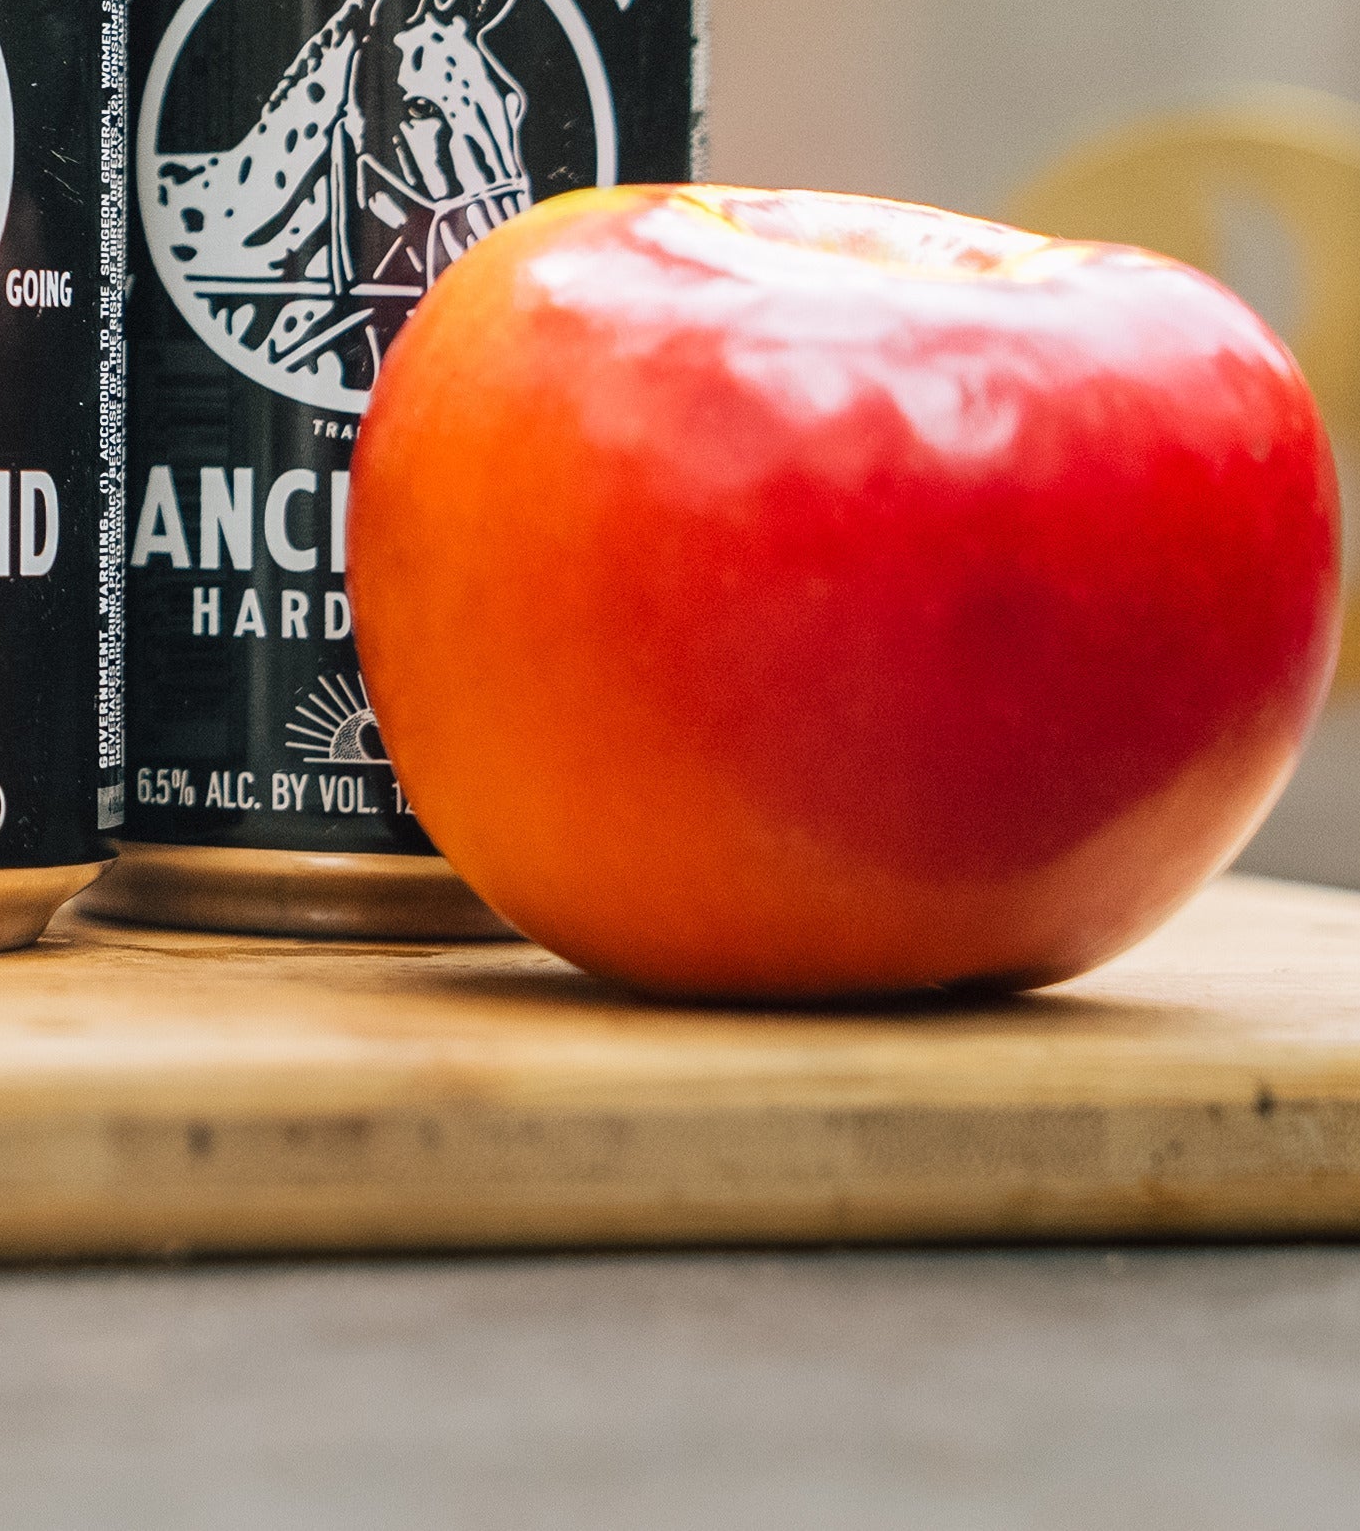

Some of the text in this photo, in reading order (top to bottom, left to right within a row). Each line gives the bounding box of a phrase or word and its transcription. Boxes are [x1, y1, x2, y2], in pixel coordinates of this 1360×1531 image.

[101, 23, 111, 89] WOMEN
[100, 194, 110, 276] SURGEON
[6, 269, 72, 309] GOING
[100, 287, 110, 319] THE
[110, 263, 117, 284] OF
[100, 329, 109, 350] TO
[109, 290, 117, 330] RISK
[109, 336, 117, 361] THE
[100, 361, 109, 461] ACCORDING
[109, 372, 117, 391] OF
[109, 400, 117, 476] BECAUSE
[100, 472, 109, 494] (1)
[108, 484, 117, 588] PREGNANCY
[130, 465, 350, 574] ANC
[99, 511, 108, 615] WARNING:
[108, 594, 116, 660] DURING
[192, 586, 352, 640] HARD
[99, 630, 108, 769] GOVERNMENT
[108, 666, 116, 767] BEVERAGES
[137, 767, 196, 806] 6.5%
[205, 771, 262, 810] ALC.
[272, 772, 308, 811] BY
[318, 774, 378, 814] VOL.
